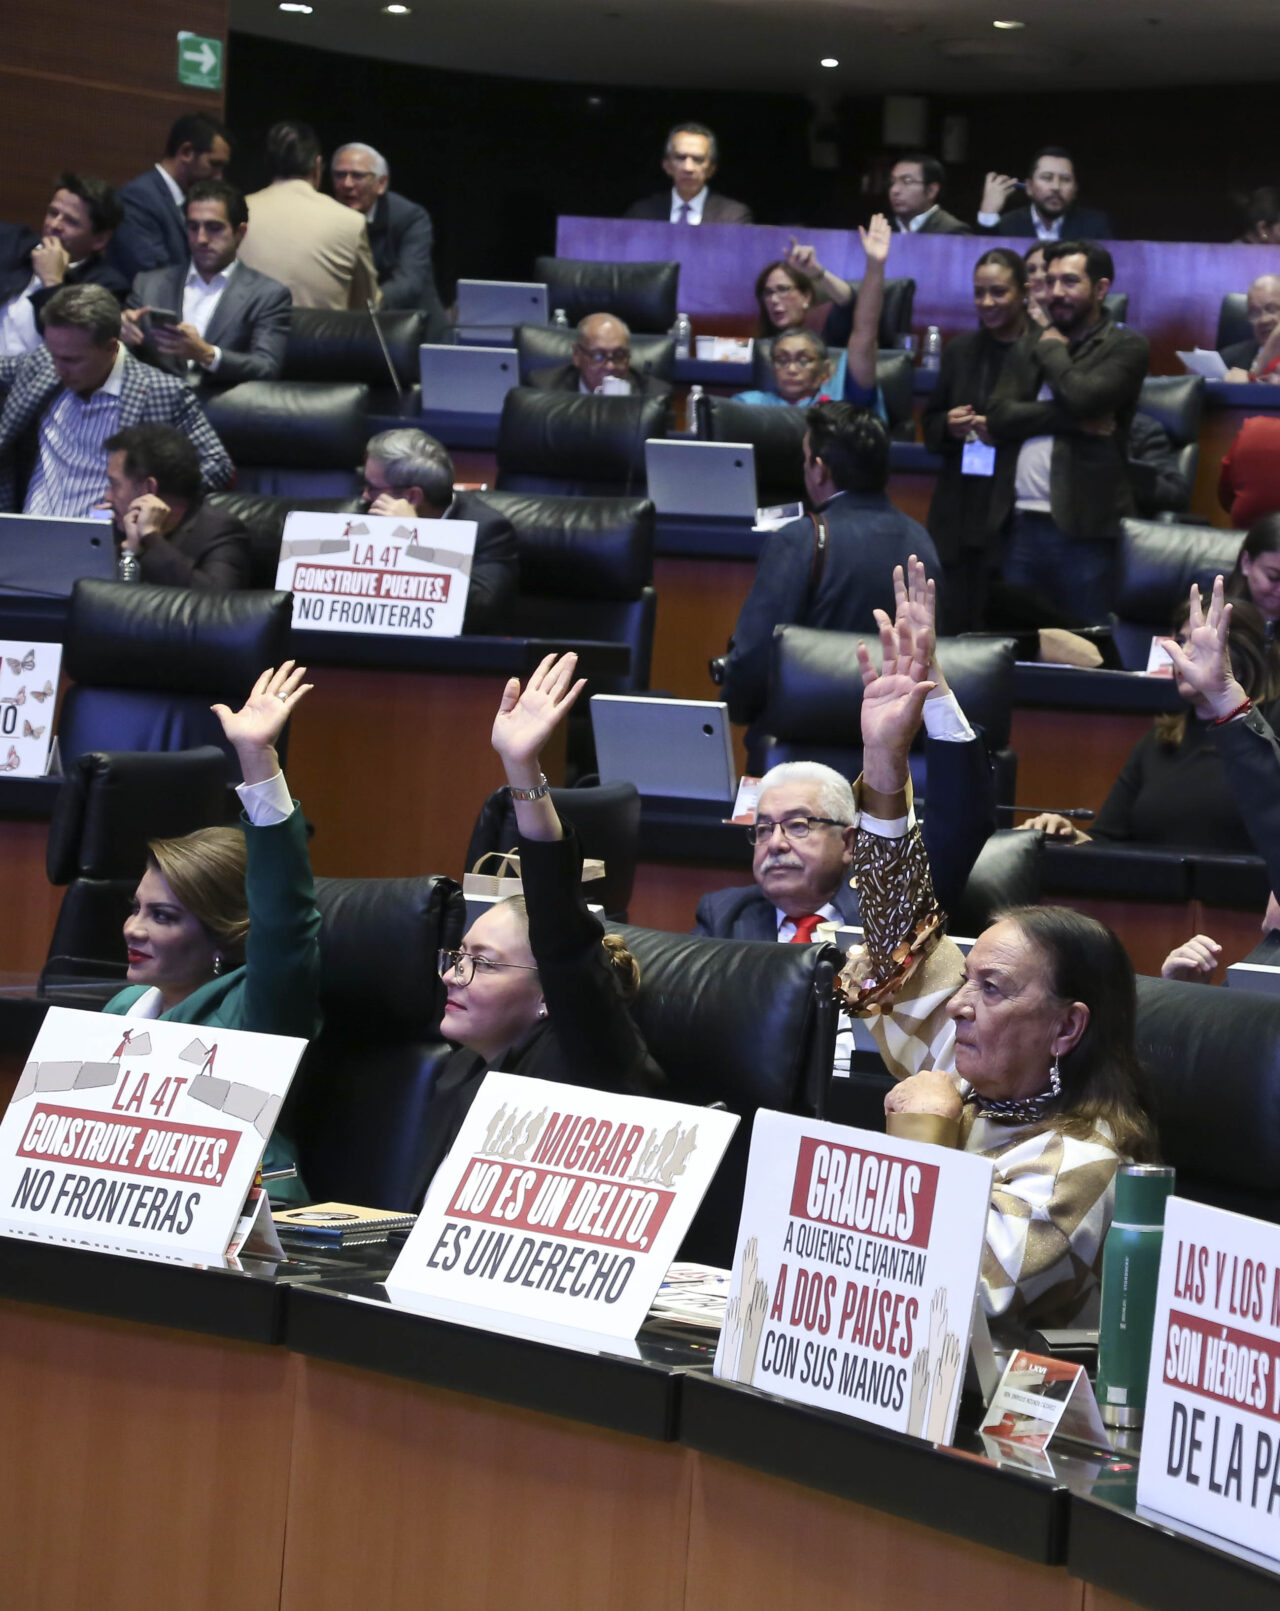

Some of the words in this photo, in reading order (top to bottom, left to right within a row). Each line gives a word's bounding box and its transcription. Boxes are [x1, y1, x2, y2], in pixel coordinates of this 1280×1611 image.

[294, 567, 378, 596] CONSTRUYE
[379, 574, 446, 602] PUENTES,
[352, 543, 374, 566] LA
[380, 546, 402, 568] 4T
[298, 598, 324, 620] NO
[328, 600, 435, 629] FRONTERAS
[0, 704, 17, 734] O
[112, 1070, 150, 1113] LA
[150, 1076, 188, 1117] 4T
[23, 1112, 142, 1167] CONSTRUYE
[134, 1129, 229, 1184] PUENTES,
[530, 1112, 645, 1178] MIGRAR
[11, 1167, 55, 1212] NO
[51, 1172, 202, 1235] FRONTERAS
[453, 1162, 503, 1214] NO
[490, 1169, 537, 1221] ES
[526, 1175, 576, 1228] UN
[562, 1181, 659, 1250] DELITO,
[806, 1144, 922, 1241] GRACIAS
[426, 1223, 472, 1272] ES
[463, 1230, 514, 1280] UN
[503, 1237, 636, 1304] DERECHO
[783, 1221, 794, 1253] A
[796, 1223, 854, 1268] QUIENES
[854, 1238, 927, 1287] LEVANTAN
[1174, 1240, 1209, 1305] LAS
[1214, 1251, 1227, 1309] Y
[1229, 1256, 1266, 1322] LOS
[770, 1263, 788, 1322] A
[790, 1268, 837, 1336] DOS
[838, 1278, 919, 1359] PAÍSES
[761, 1330, 800, 1379] CON
[800, 1340, 838, 1391] SUS
[838, 1352, 907, 1412] MANOS
[1166, 1324, 1203, 1387] SON
[1203, 1328, 1270, 1410] HÉROES
[1166, 1401, 1206, 1487] DE
[1208, 1414, 1244, 1502] LA
